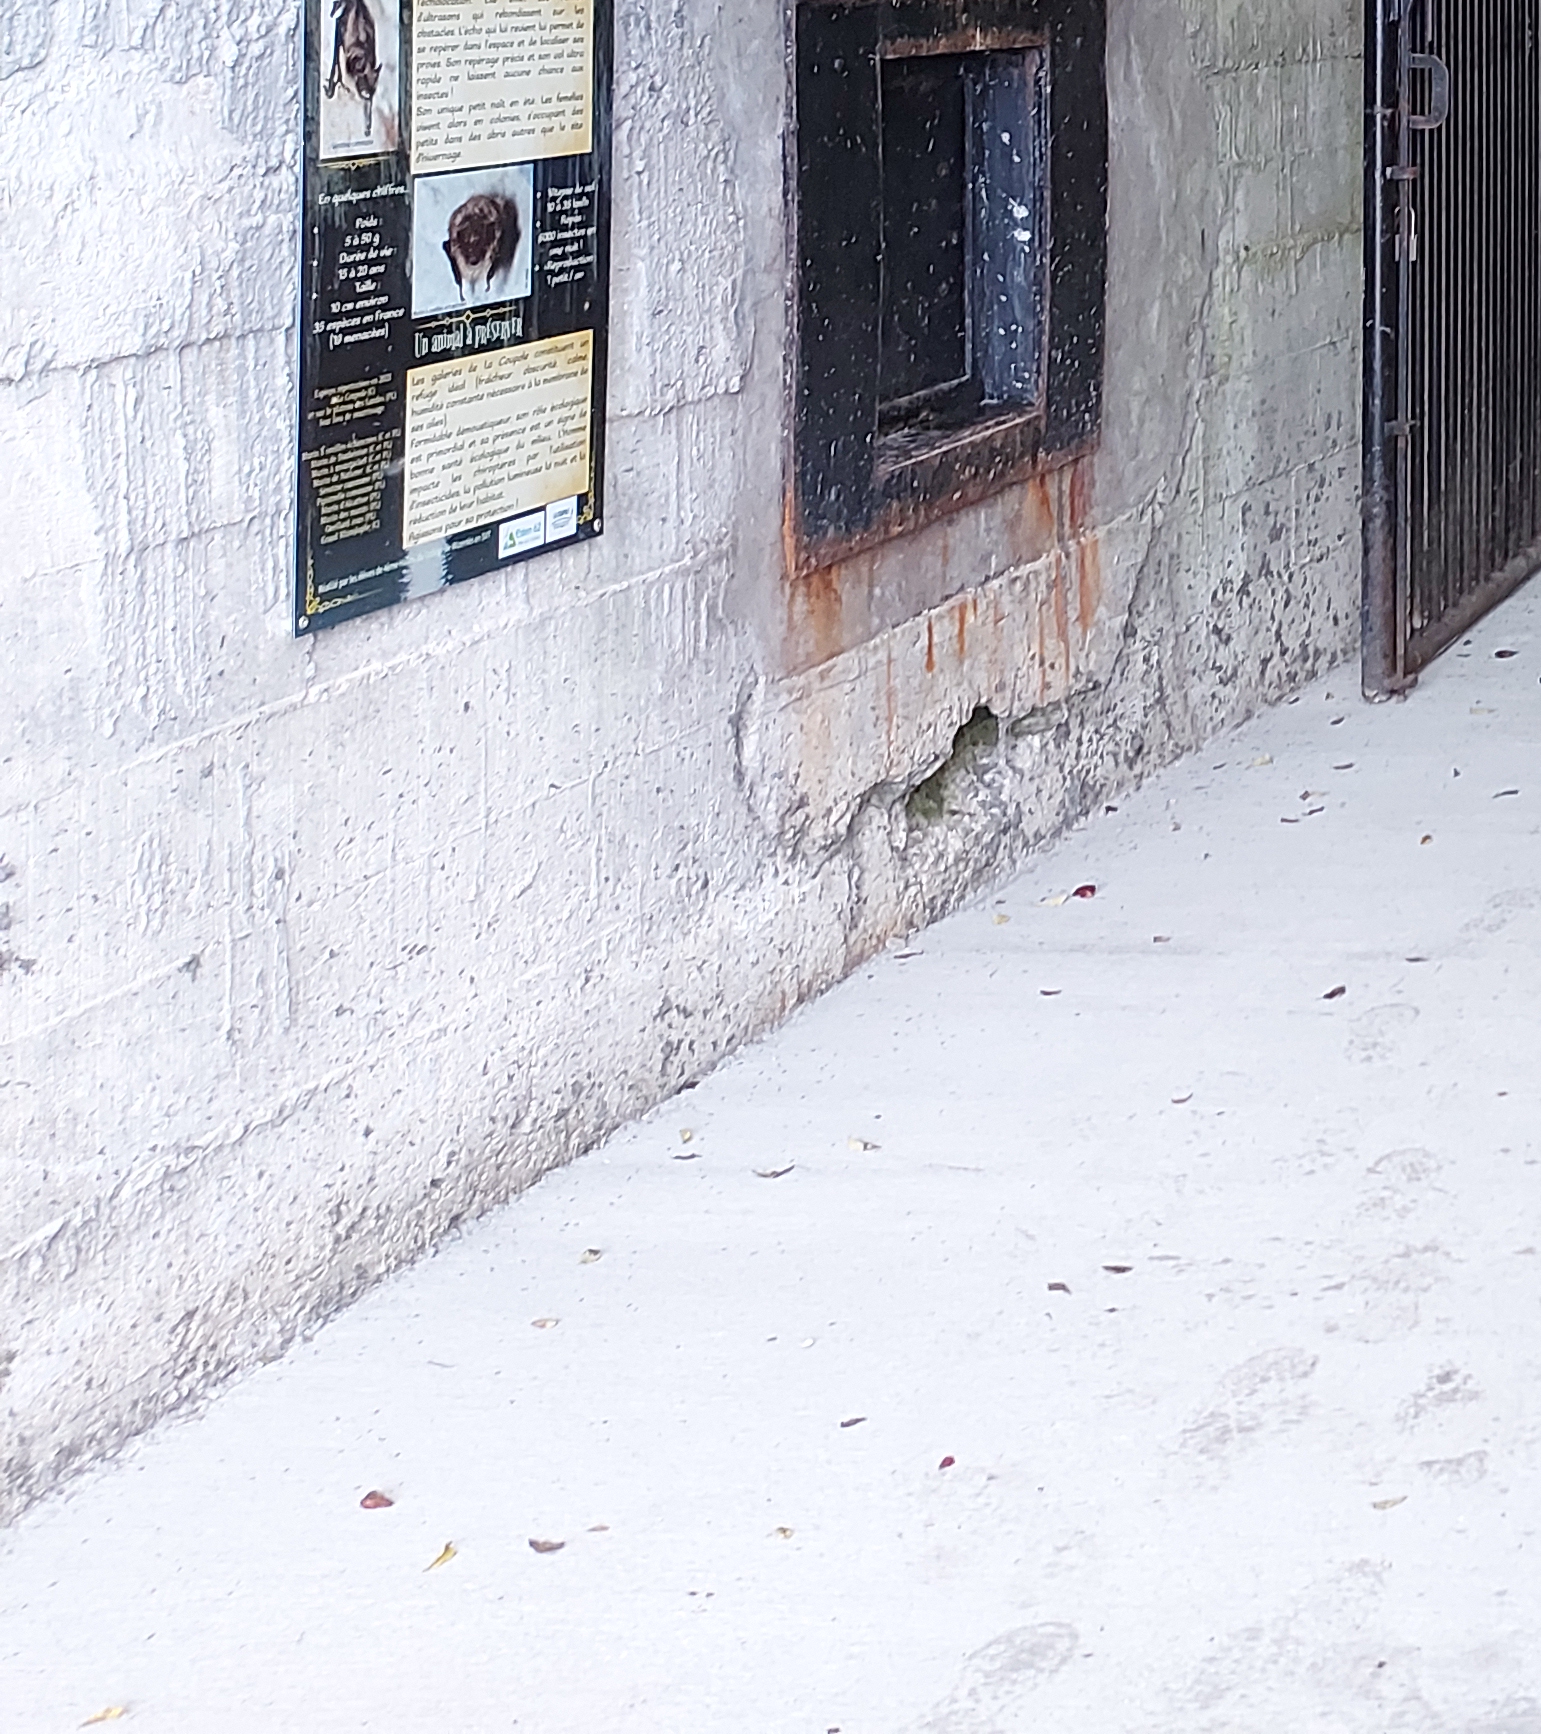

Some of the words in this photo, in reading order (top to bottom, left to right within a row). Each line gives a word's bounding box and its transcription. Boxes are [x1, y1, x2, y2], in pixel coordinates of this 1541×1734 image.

[344, 235, 351, 246] 5
[360, 231, 371, 244] 50
[373, 232, 379, 246] g
[356, 264, 367, 277] 20
[312, 320, 324, 334] 35
[414, 332, 428, 358] Un
